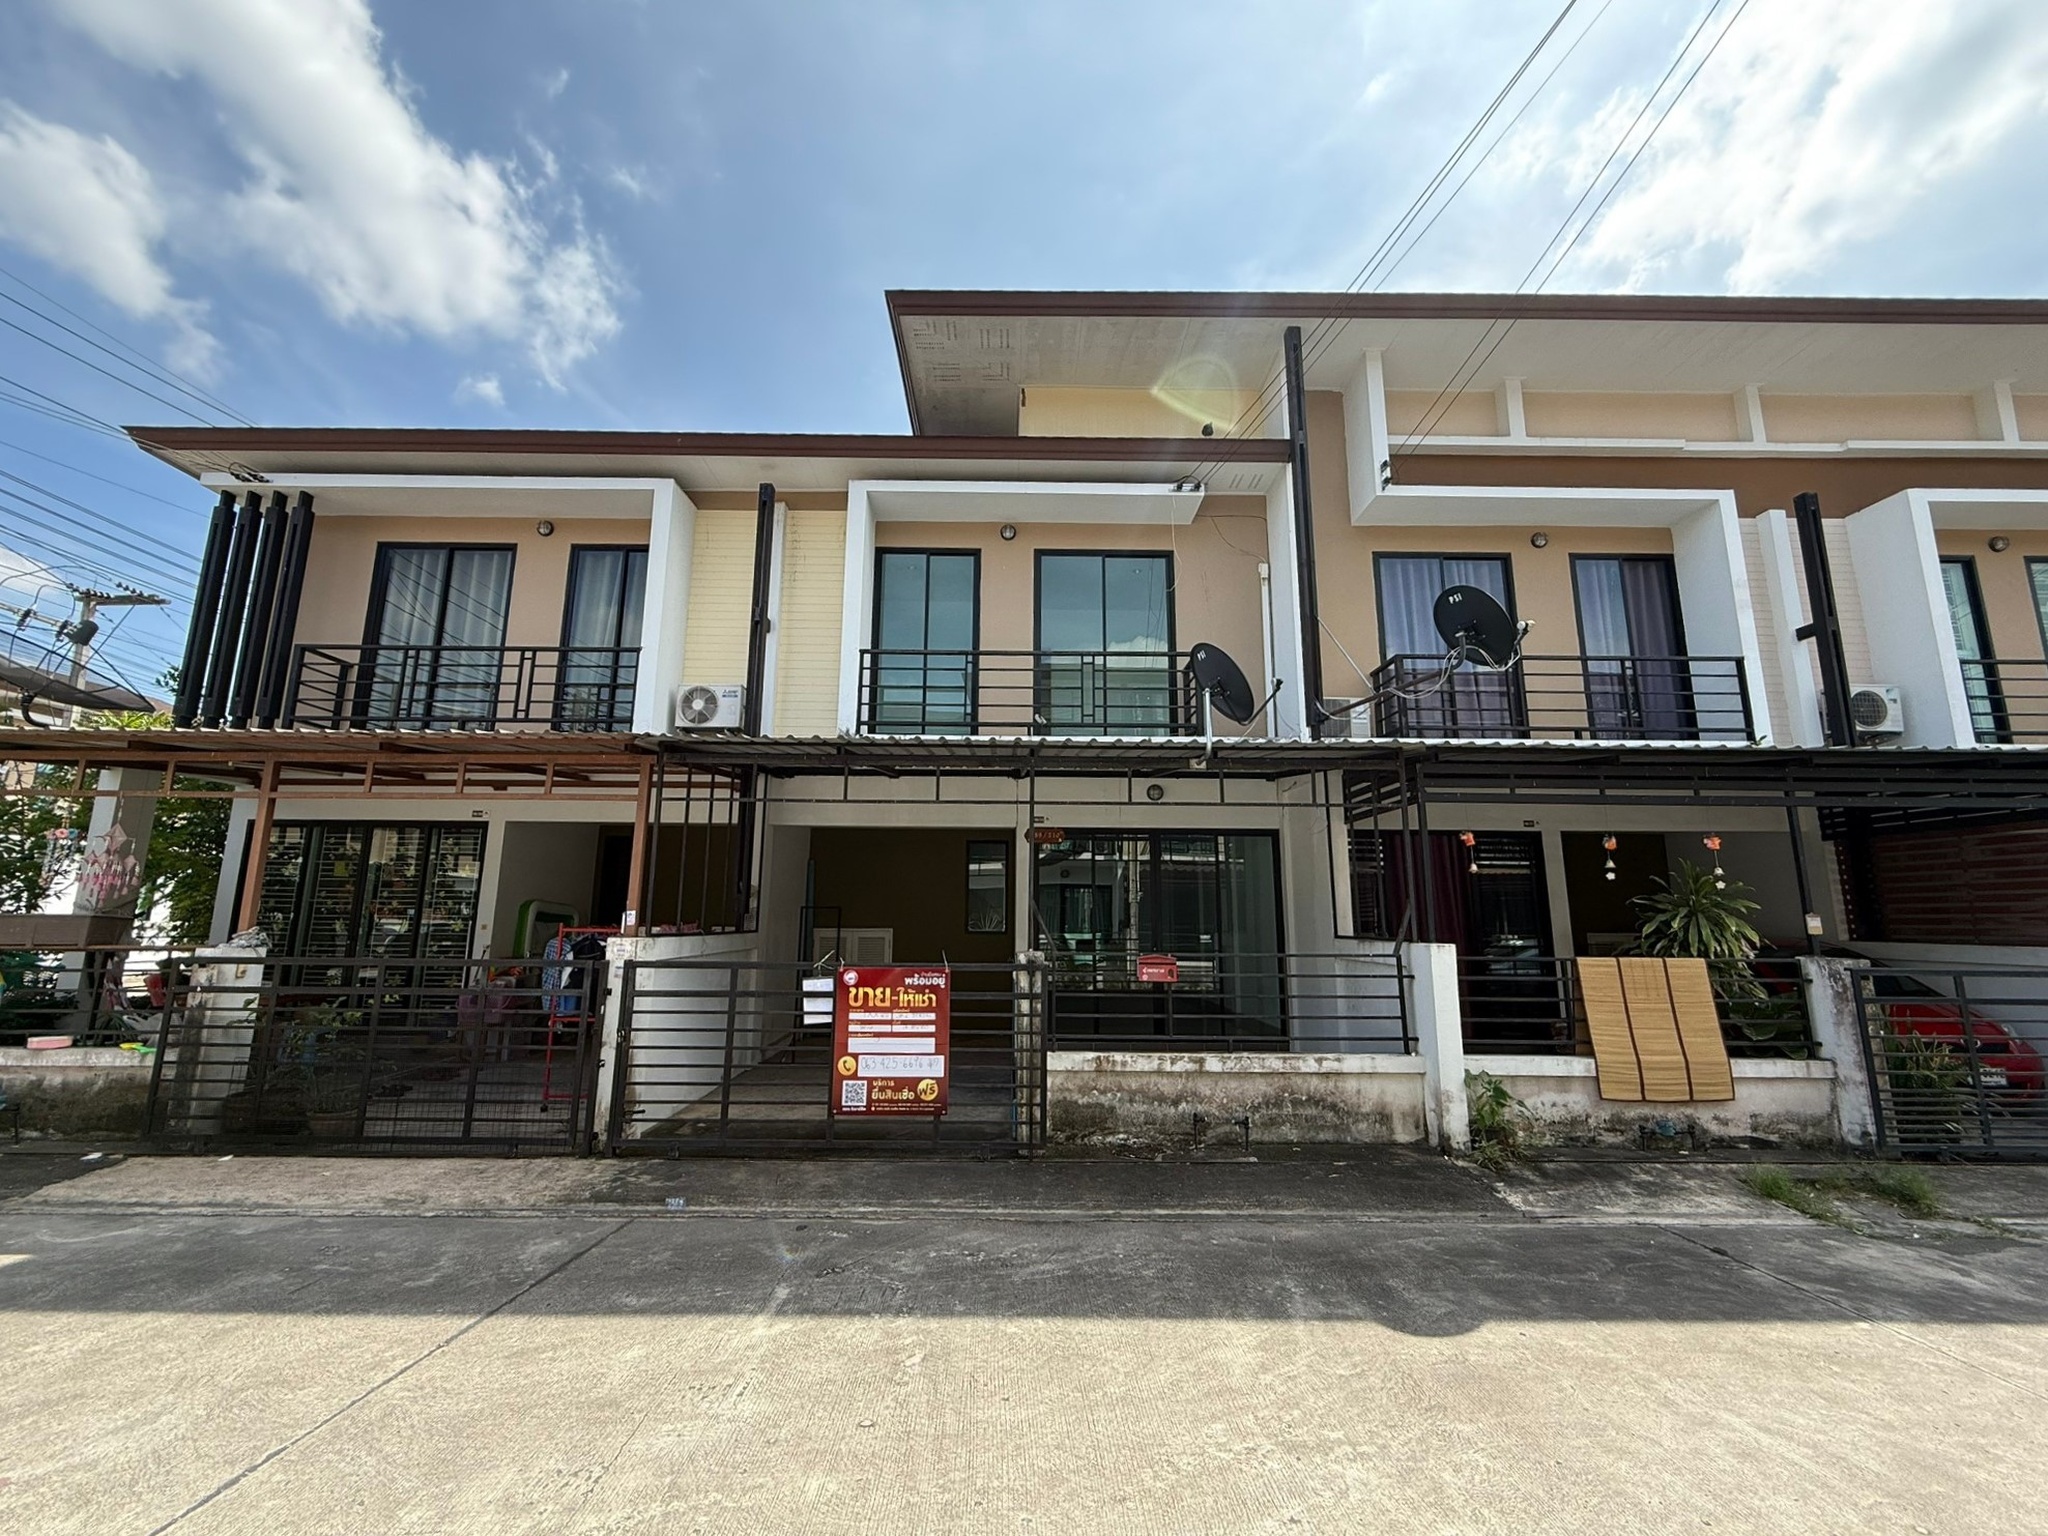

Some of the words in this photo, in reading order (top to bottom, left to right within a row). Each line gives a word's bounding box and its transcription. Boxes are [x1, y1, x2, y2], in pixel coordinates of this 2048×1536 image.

[1448, 592, 1463, 605] PSI
[904, 973, 946, 989] พร้อมอยู่
[872, 1079, 895, 1087] บริการ
[918, 1080, 937, 1096] ฟรี
[871, 1086, 915, 1100] ยื่นสินเชื่อ
